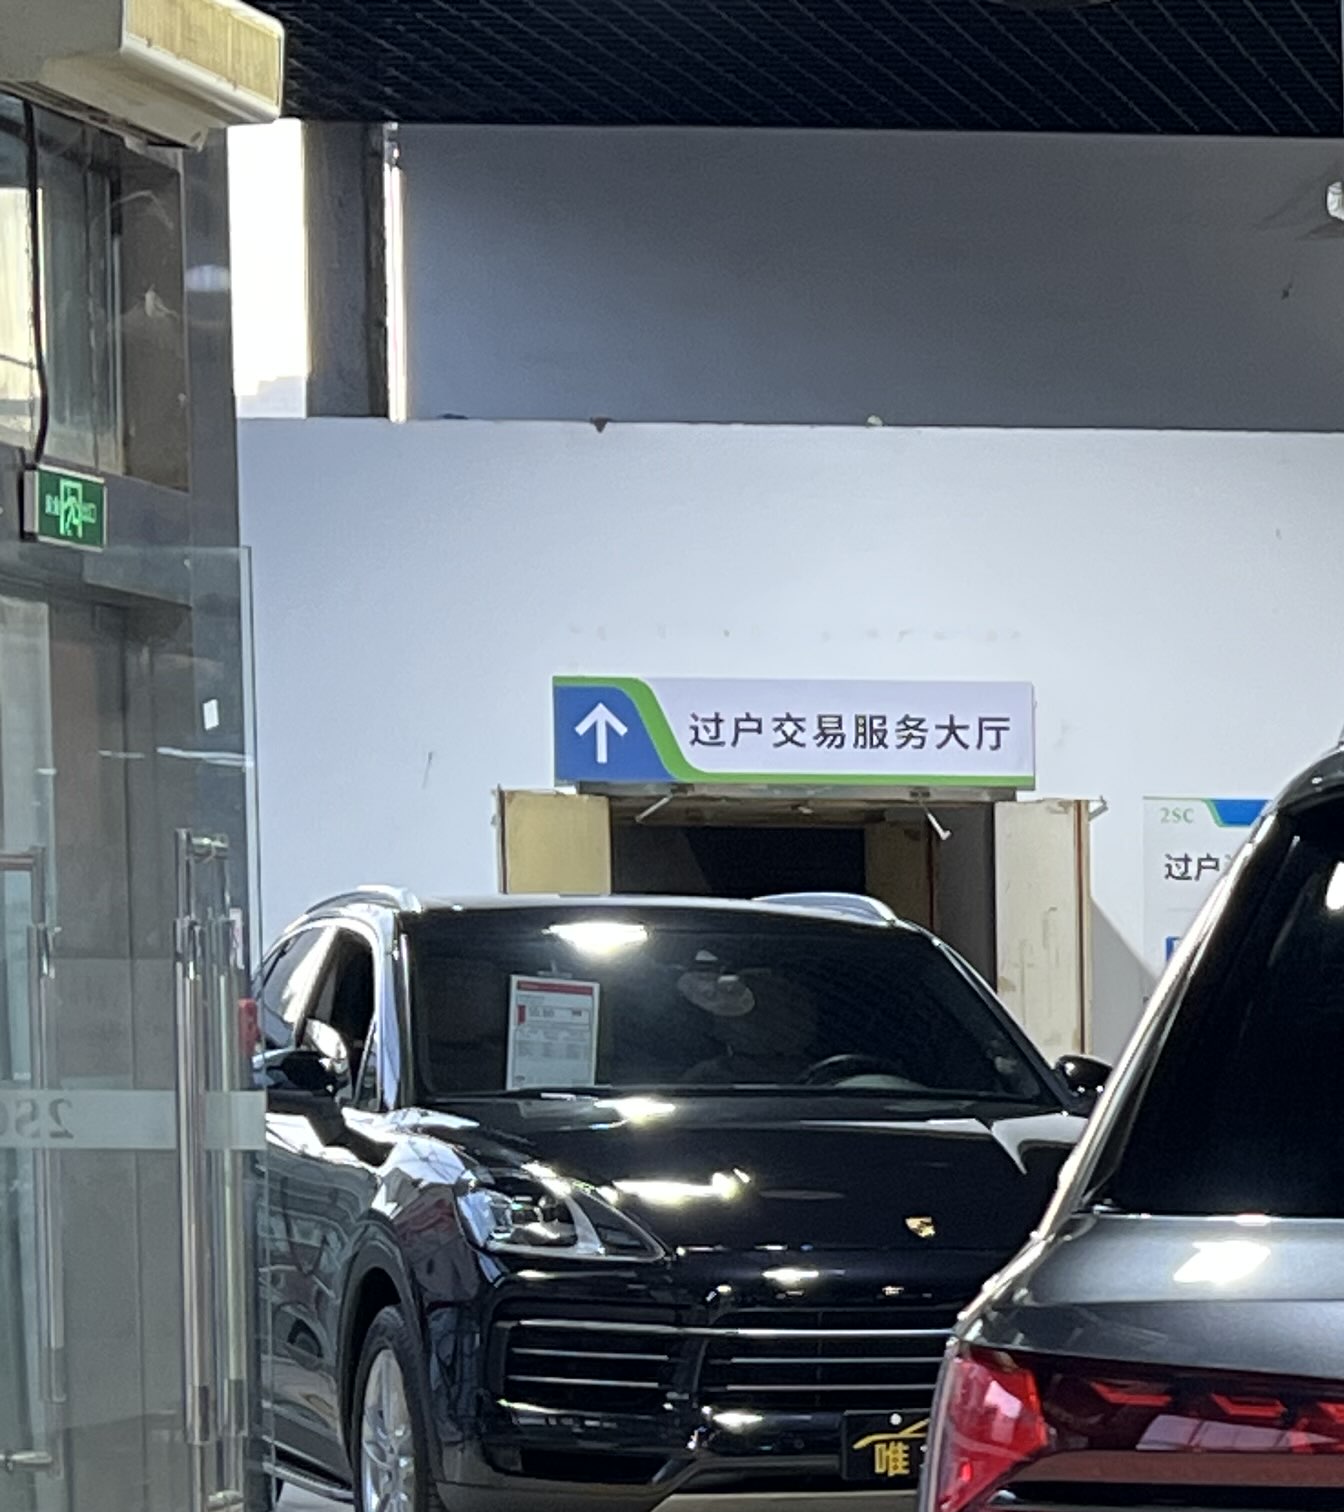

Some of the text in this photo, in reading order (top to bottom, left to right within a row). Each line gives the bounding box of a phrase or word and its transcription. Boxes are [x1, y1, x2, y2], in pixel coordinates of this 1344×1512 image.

[689, 711, 1011, 751] 过户交易服务大厅
[1160, 807, 1195, 824] 2SC
[1164, 852, 1232, 882] 过户
[874, 1440, 911, 1478] 唯
